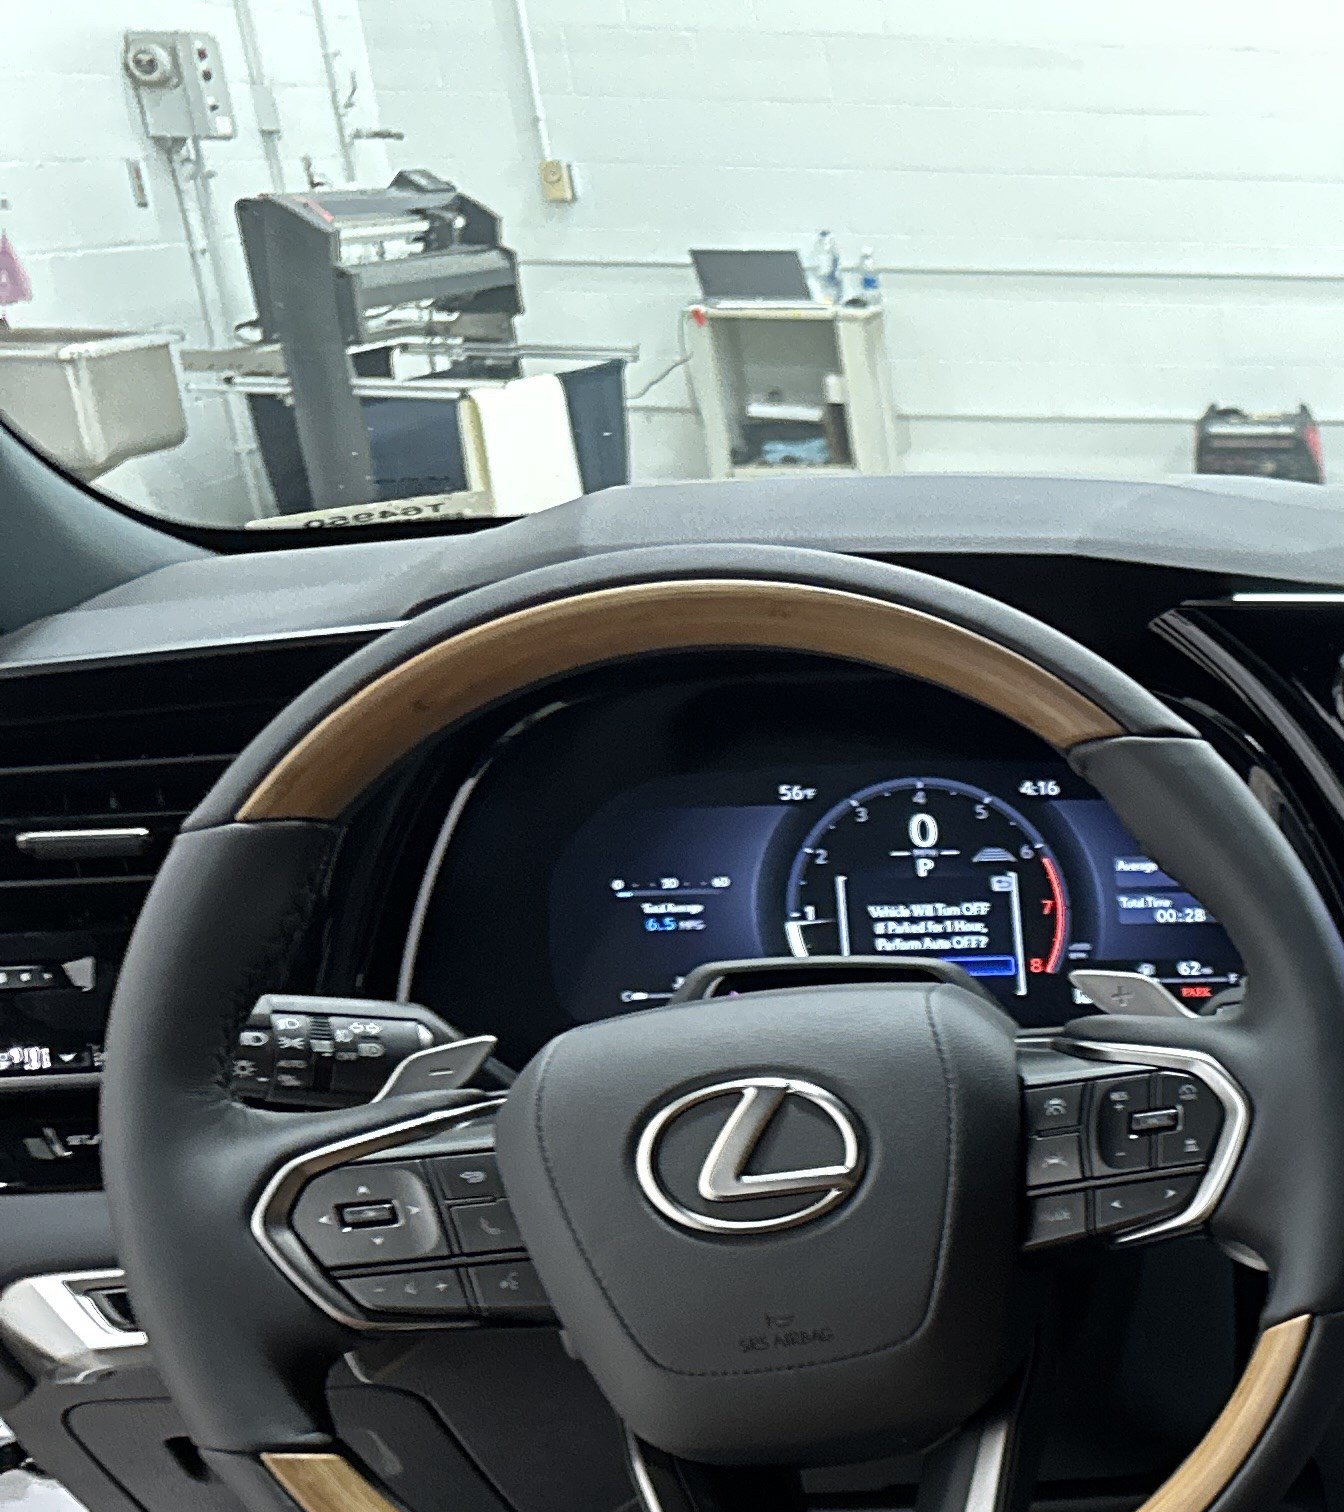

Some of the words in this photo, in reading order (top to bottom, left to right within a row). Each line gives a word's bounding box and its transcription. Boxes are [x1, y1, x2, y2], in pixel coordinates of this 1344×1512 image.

[854, 806, 869, 822] 3
[974, 803, 990, 820] 5
[908, 813, 939, 848] 0
[814, 848, 829, 865] 2
[1019, 844, 1035, 860] 6
[916, 858, 935, 877] P
[803, 905, 816, 920] 1
[1041, 899, 1054, 915] 7
[1154, 907, 1207, 923] 00:28
[1029, 957, 1045, 973] 8
[1176, 960, 1202, 976] 62
